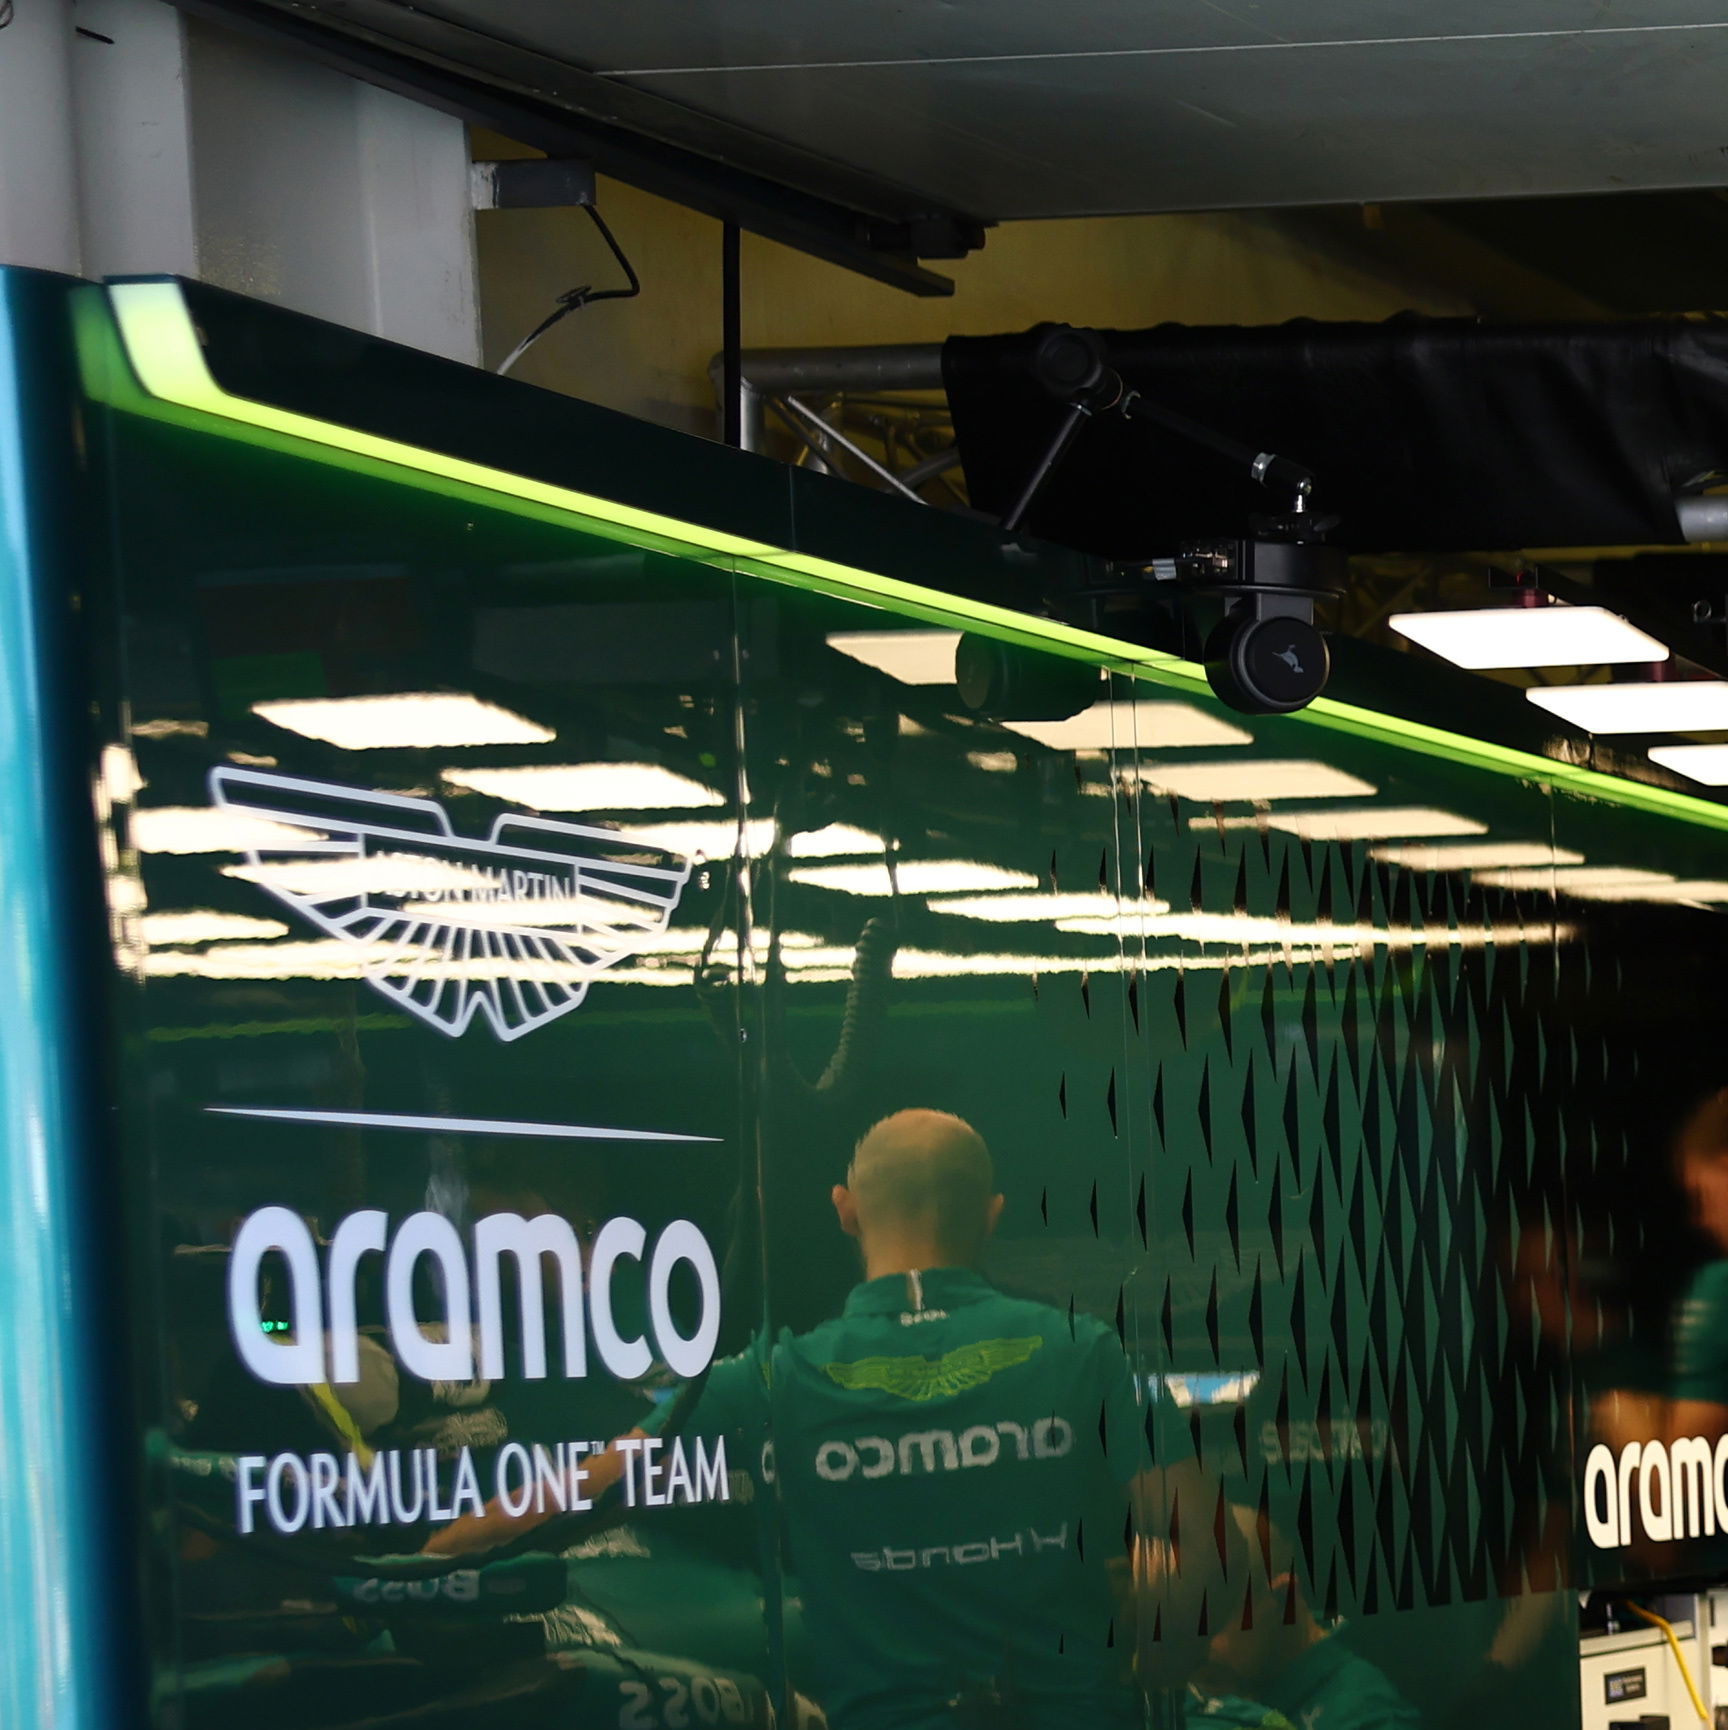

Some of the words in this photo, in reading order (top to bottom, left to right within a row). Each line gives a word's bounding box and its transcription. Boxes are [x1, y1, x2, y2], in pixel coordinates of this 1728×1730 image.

[228, 1205, 722, 1386] aramco
[235, 1445, 486, 1534] FORMULA
[615, 1434, 730, 1508] TEAM
